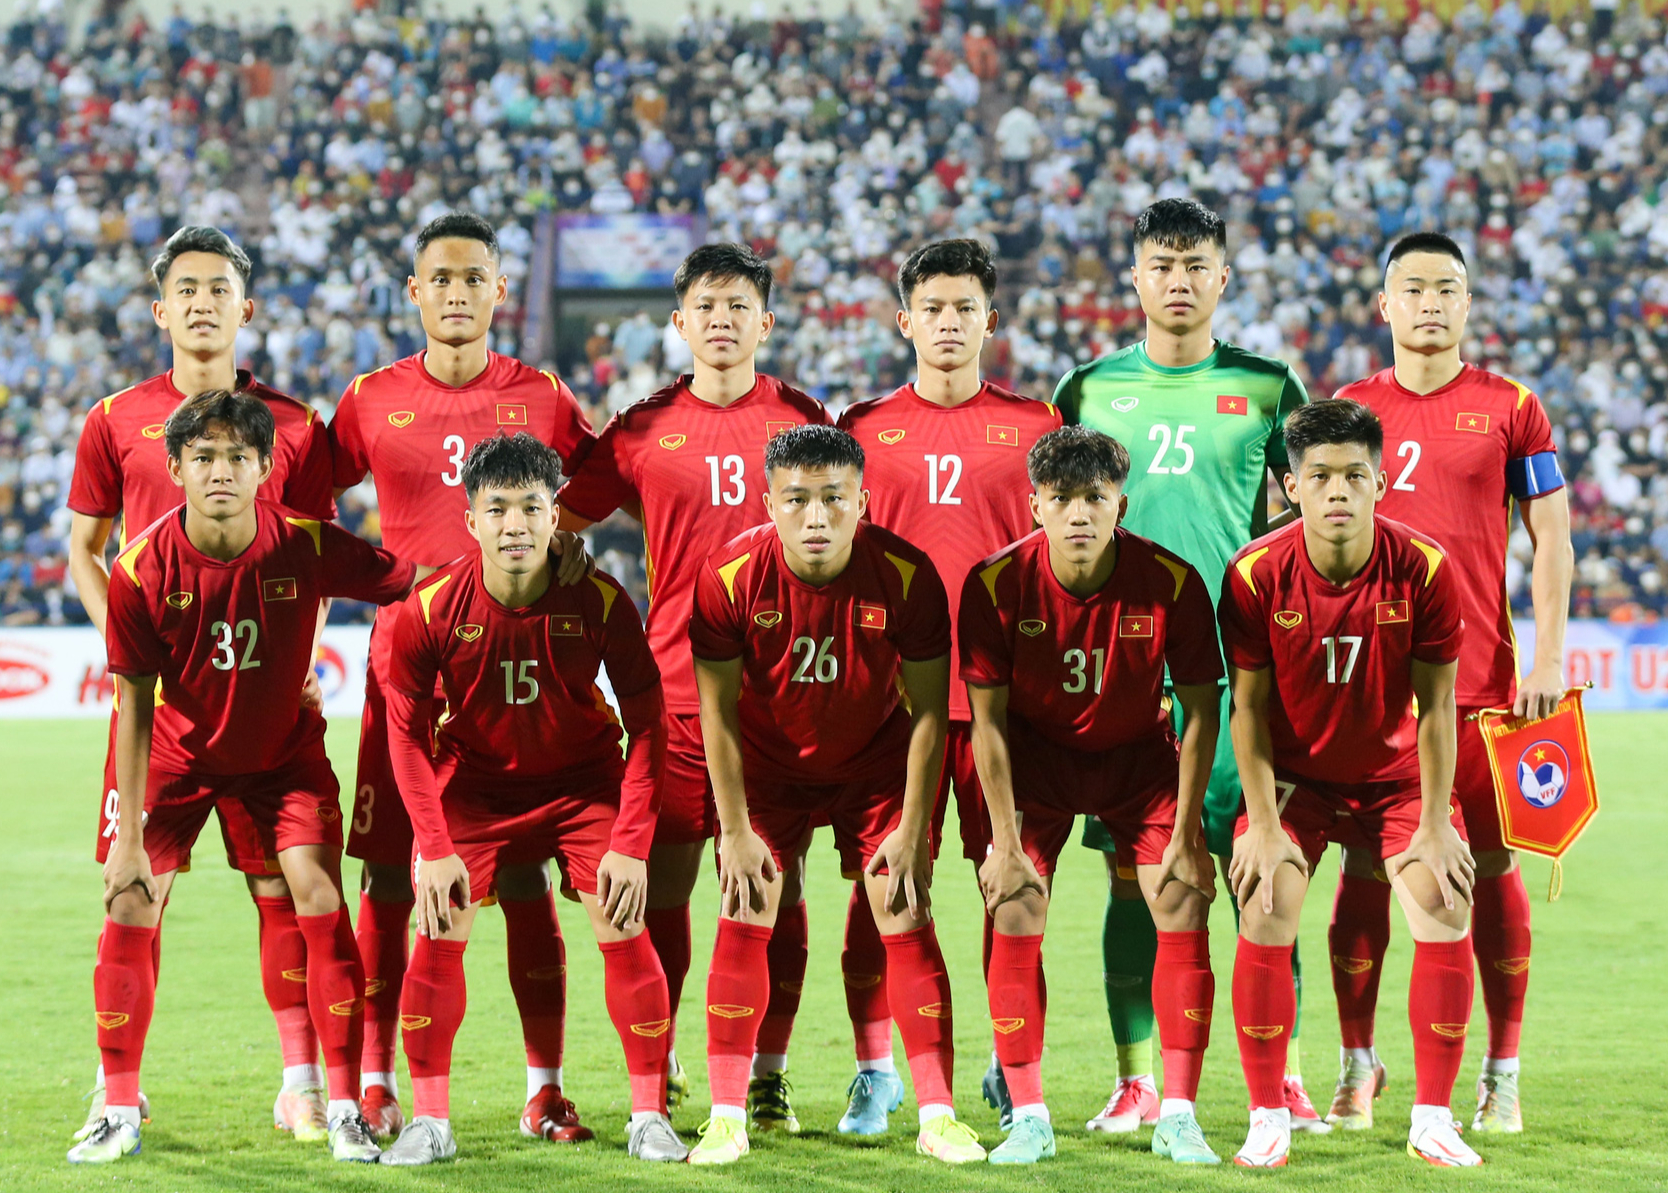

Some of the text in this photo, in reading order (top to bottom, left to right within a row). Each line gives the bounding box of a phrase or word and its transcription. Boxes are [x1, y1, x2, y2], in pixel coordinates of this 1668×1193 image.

[441, 434, 465, 487] 3
[1146, 423, 1196, 476] 25
[1392, 440, 1422, 492] 2
[706, 454, 746, 506] 13
[924, 454, 963, 505] 12
[210, 618, 261, 671] 32
[791, 635, 838, 684] 26
[1321, 635, 1364, 684] 17
[500, 660, 540, 706] 15
[1063, 647, 1104, 695] 31
[353, 784, 375, 835] 3
[1540, 786, 1555, 800] VFF
